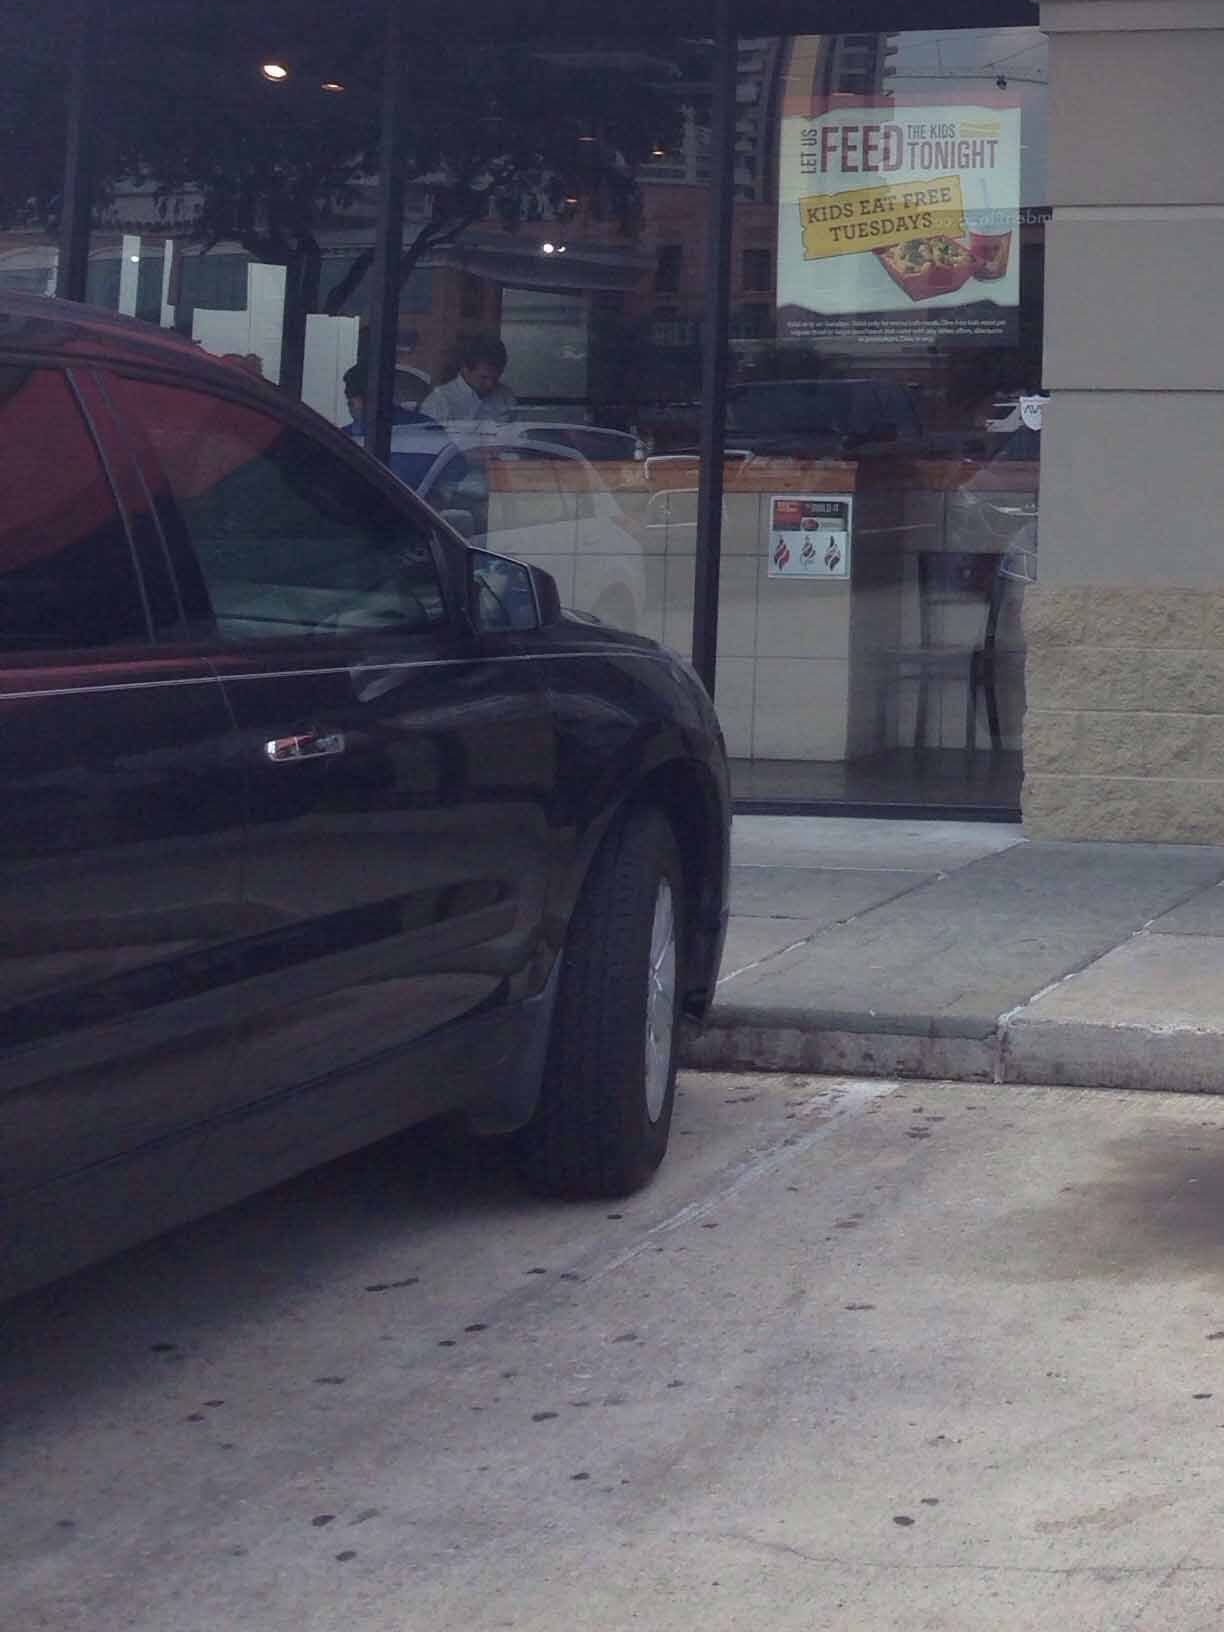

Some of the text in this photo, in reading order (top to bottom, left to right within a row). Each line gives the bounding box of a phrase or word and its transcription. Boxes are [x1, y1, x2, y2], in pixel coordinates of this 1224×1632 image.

[907, 122, 956, 140] THE KIDS
[800, 128, 818, 174] LET US
[820, 124, 904, 173] FEED
[906, 139, 999, 169] TONIGHT
[807, 187, 953, 224] KIDS EAT FREE
[830, 212, 933, 242] TUESDAYS
